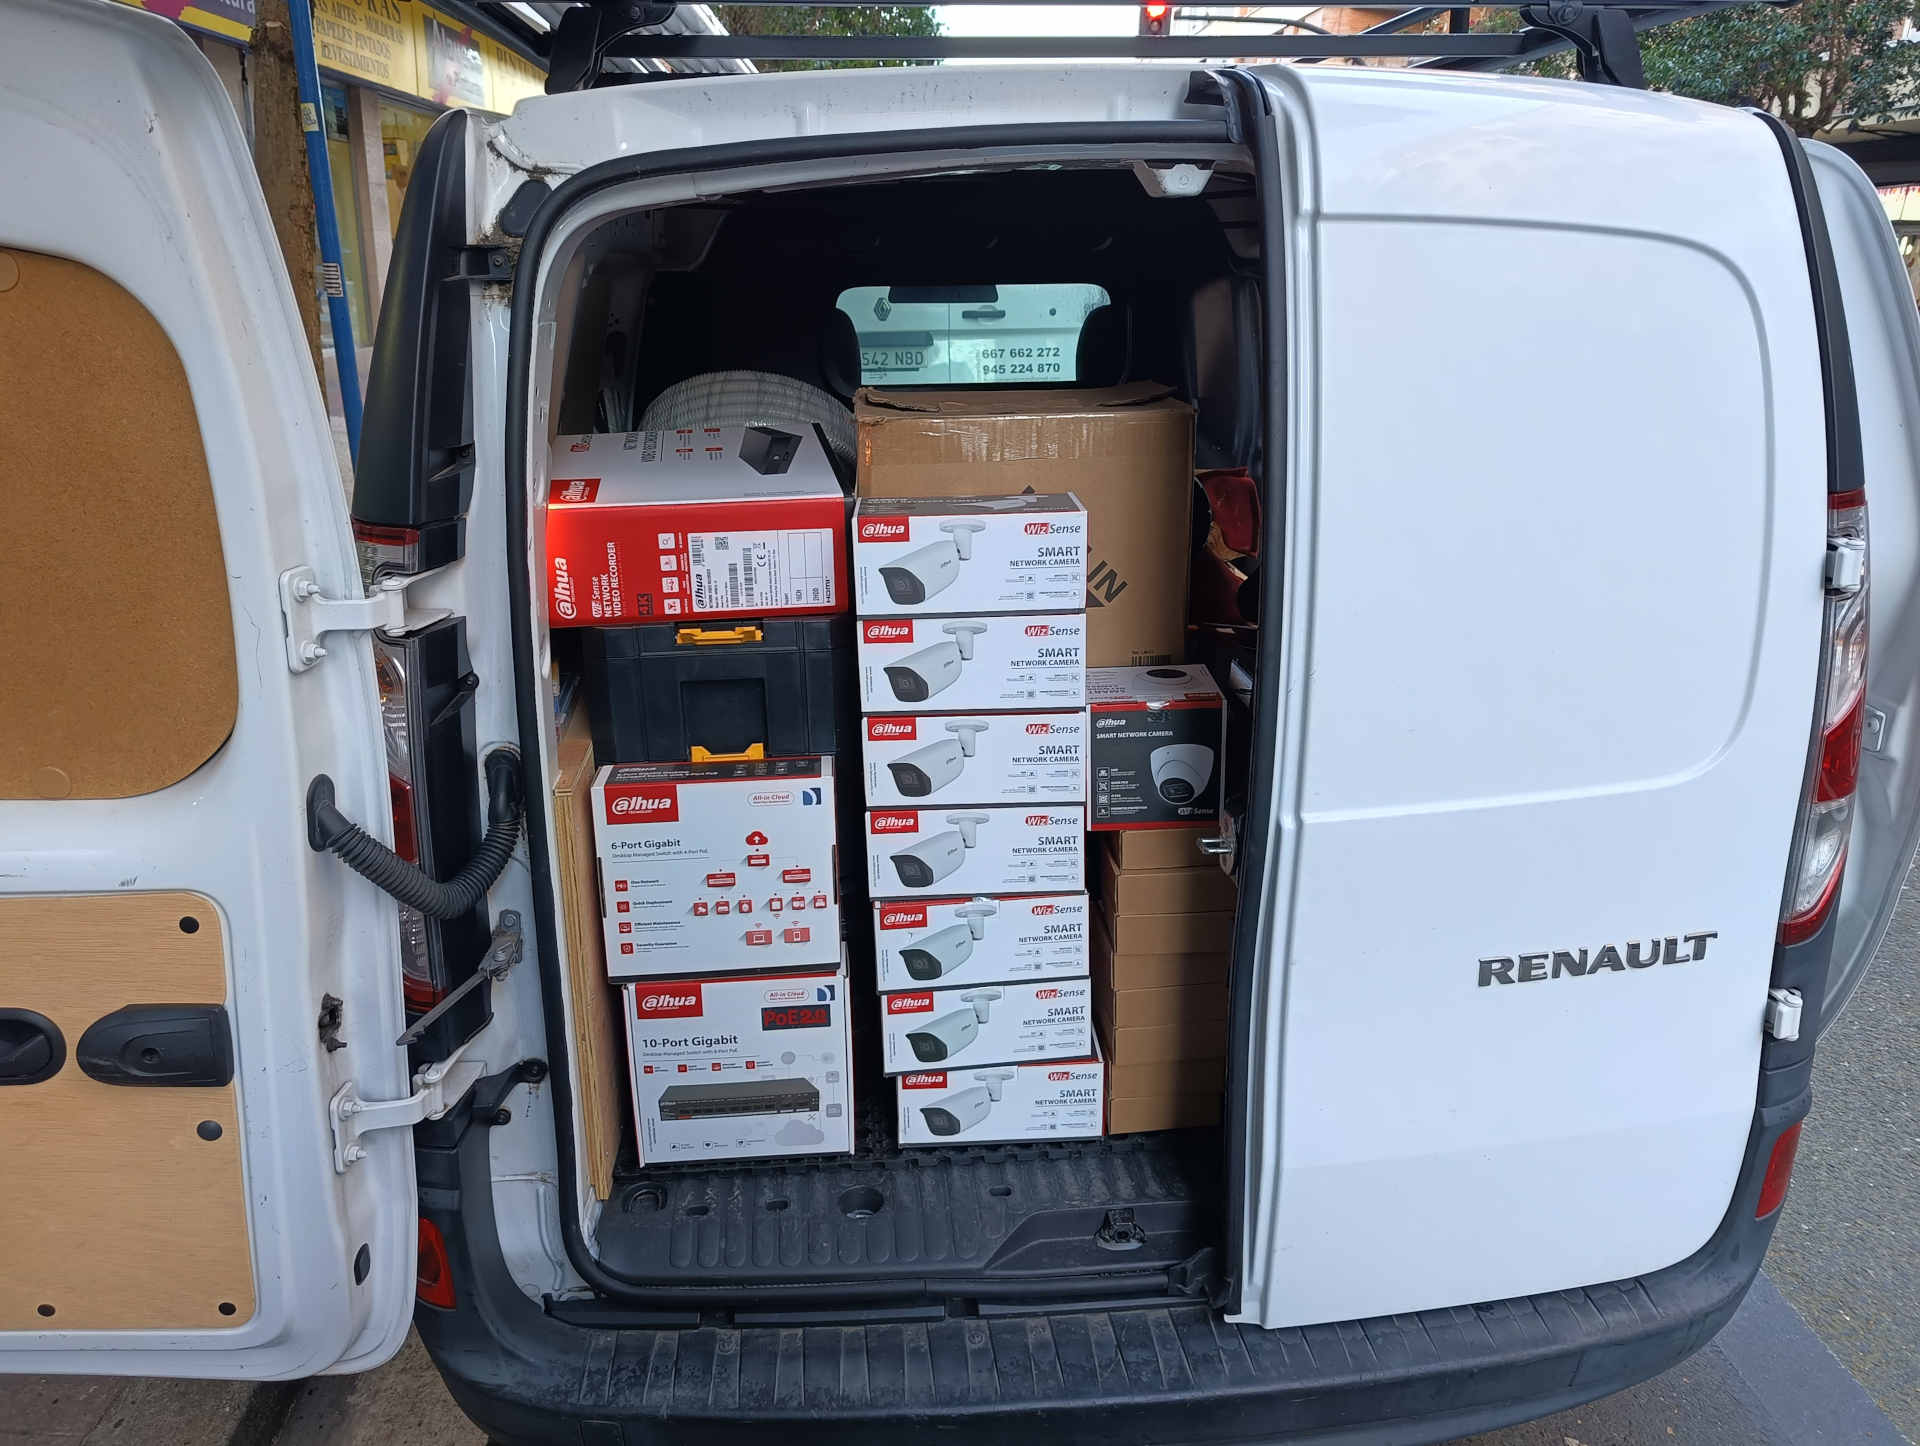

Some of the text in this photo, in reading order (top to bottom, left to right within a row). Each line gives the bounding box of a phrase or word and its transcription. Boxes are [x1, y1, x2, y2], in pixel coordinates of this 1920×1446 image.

[355, 32, 392, 60] PINTADOS
[982, 347, 1060, 359] 667 662 272
[983, 362, 1060, 375] 945 224 870
[1037, 546, 1080, 558] SMART
[1010, 558, 1080, 568] NETWORK CAMERA
[608, 541, 622, 617] VIDEO RECORDER
[1087, 559, 1129, 604] IN
[601, 573, 613, 618] NETWORK
[1037, 647, 1080, 659] SMART
[1010, 658, 1080, 667] NETWORK CAMERA
[1096, 732, 1117, 740] SMART
[1117, 731, 1147, 739] NETWORK
[1038, 744, 1080, 755] SMART
[1012, 755, 1080, 764] NETWORK CAMERA
[611, 839, 681, 850] 6-Port Gigabit
[1037, 835, 1079, 846] SMART
[1012, 847, 1048, 855] NETWORK
[1043, 923, 1082, 935] SMART
[1018, 933, 1083, 944] NETWORK CAMERA
[1477, 930, 1719, 987] RENAULT
[1047, 1006, 1085, 1017] SMART
[1023, 1015, 1085, 1027] NETWORK CAMERA
[642, 1034, 739, 1049] 10-Port Gigabit
[1059, 1088, 1097, 1098] SMART
[1034, 1097, 1097, 1106] NETWORK CAMERA
